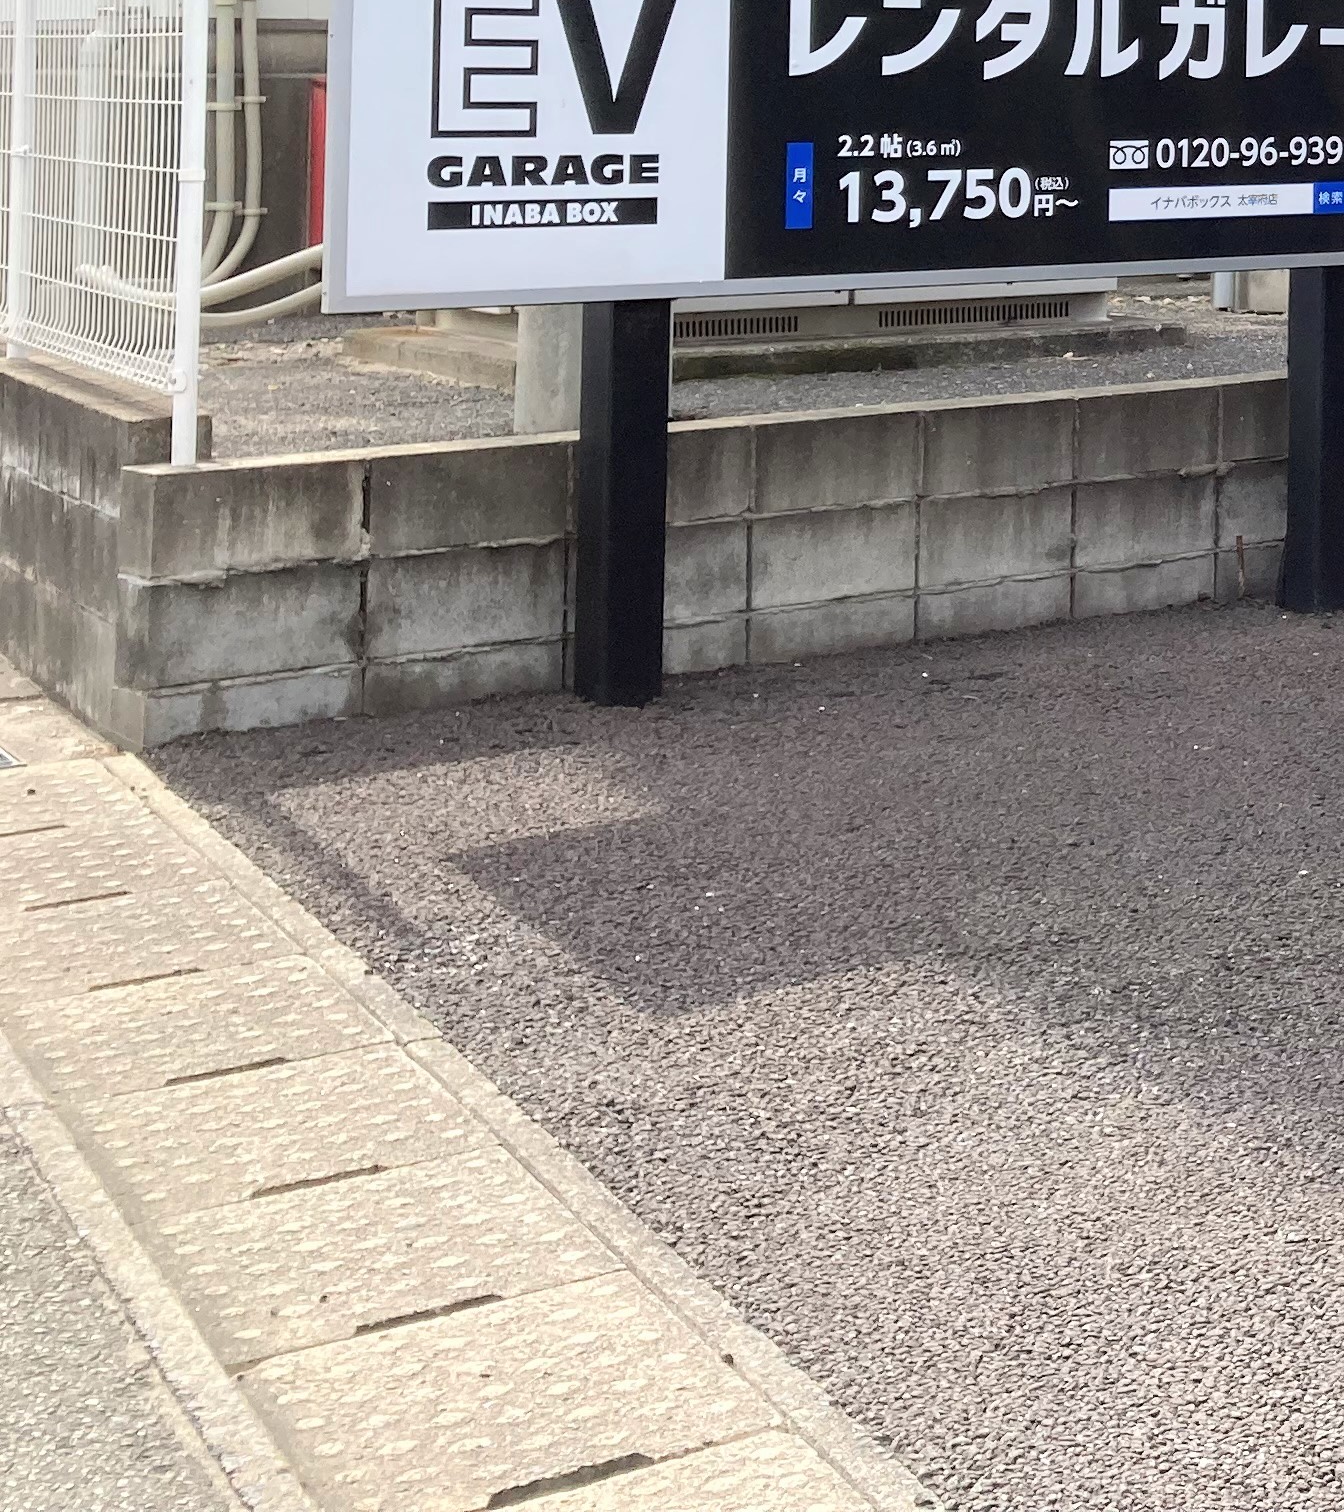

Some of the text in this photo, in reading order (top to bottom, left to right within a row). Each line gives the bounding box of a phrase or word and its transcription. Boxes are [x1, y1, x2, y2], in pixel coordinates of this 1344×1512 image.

[427, 153, 660, 188] GARAGE
[792, 167, 807, 203] 月々
[1318, 191, 1343, 205] 検索
[470, 198, 620, 226] INABA BOX
[1150, 194, 1232, 210] イナバボックス
